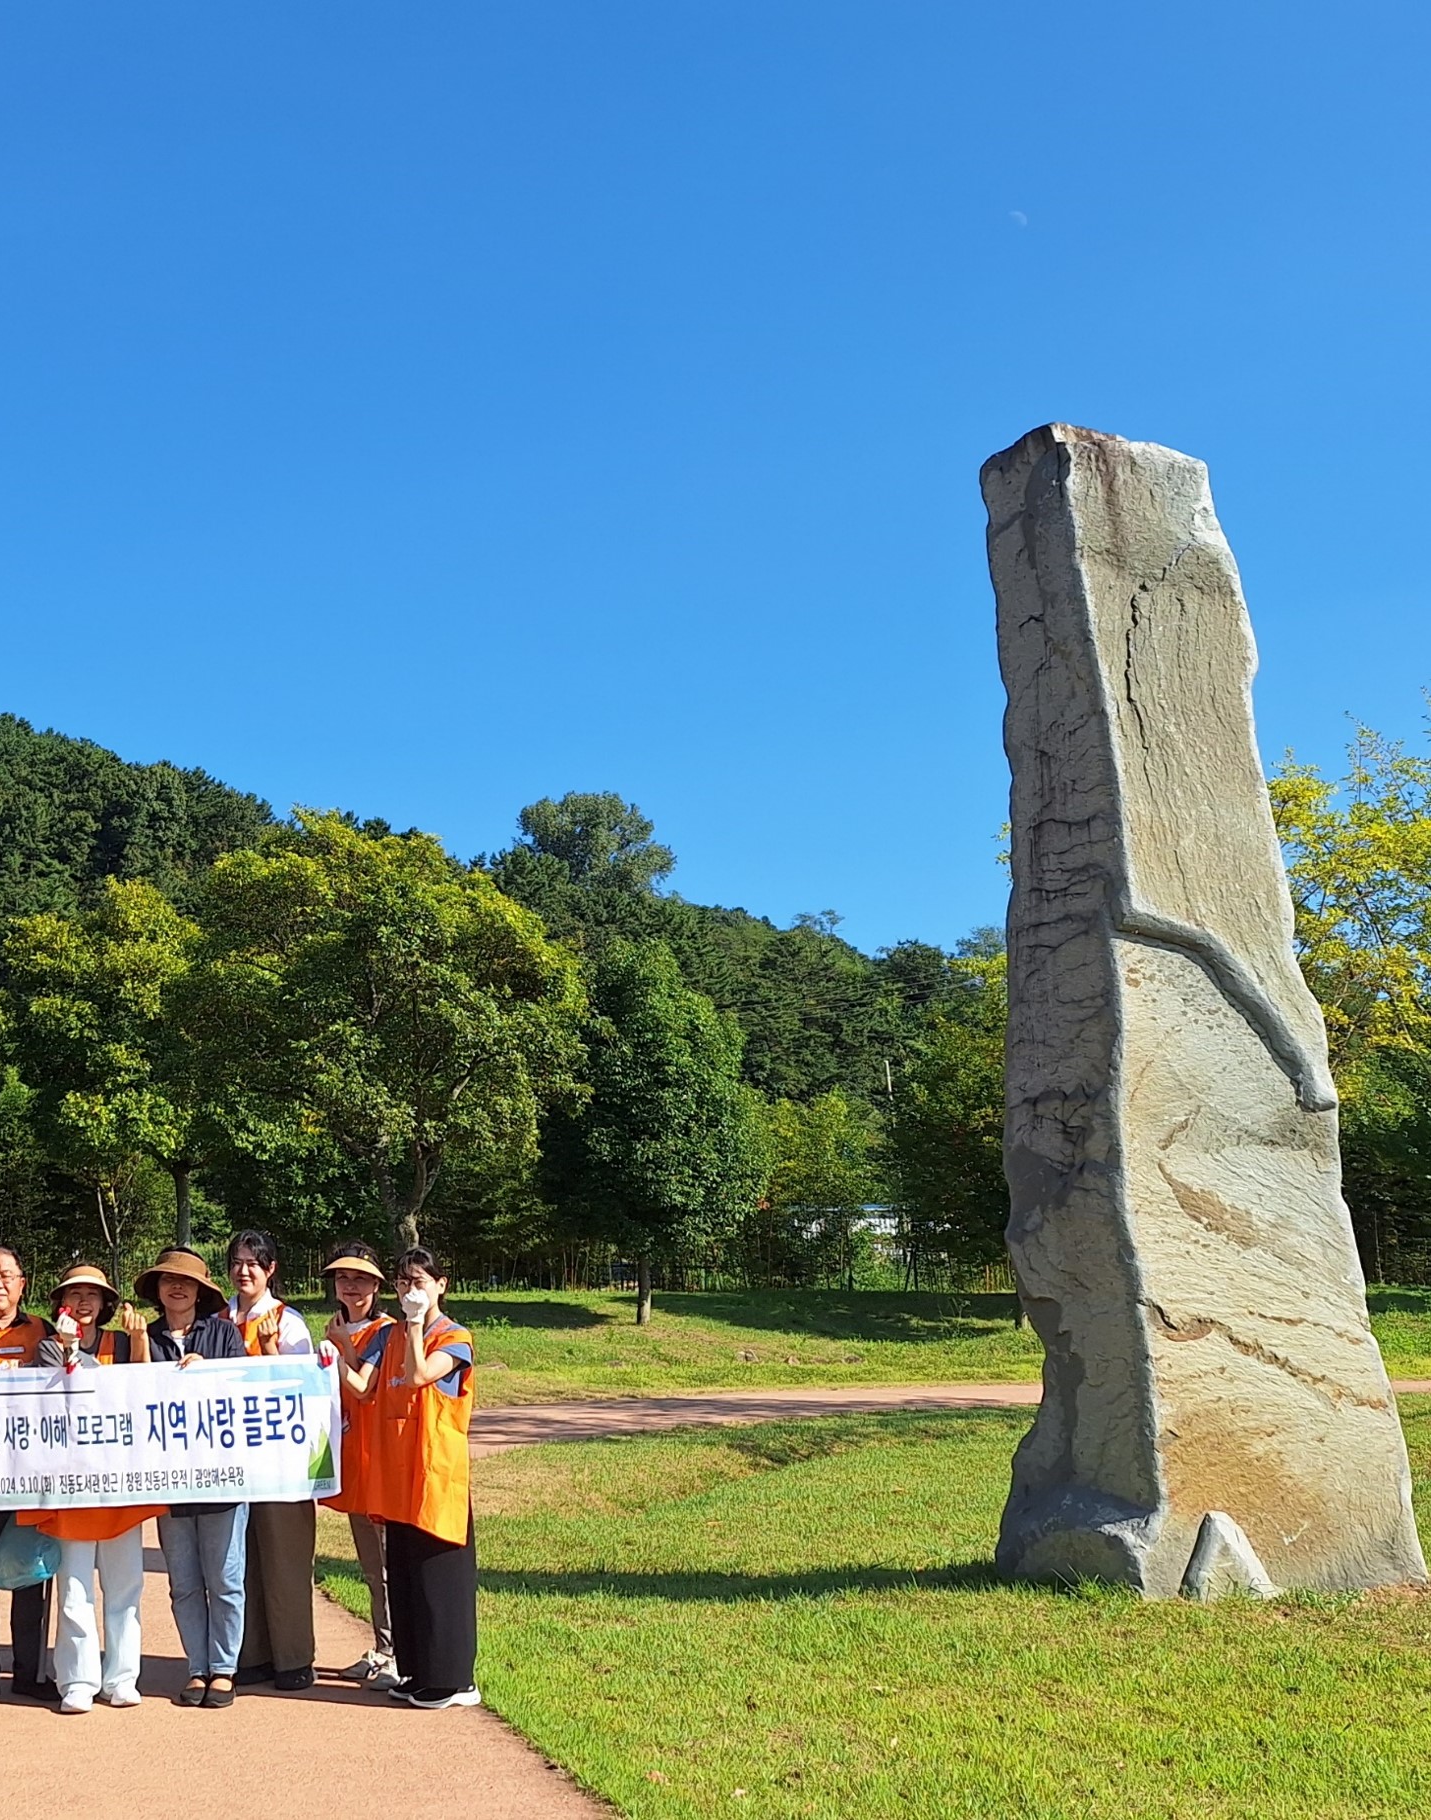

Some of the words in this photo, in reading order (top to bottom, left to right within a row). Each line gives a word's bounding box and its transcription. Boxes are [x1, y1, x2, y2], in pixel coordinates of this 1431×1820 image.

[77, 1412, 133, 1446] 프로그램
[146, 1400, 188, 1451] 지역
[196, 1397, 236, 1449] 사랑
[242, 1393, 306, 1447] 플로깅
[59, 1473, 100, 1495] 진동도서관
[102, 1472, 118, 1493] 인근
[126, 1471, 142, 1492] 창원
[144, 1470, 169, 1491] 진동리
[171, 1469, 188, 1490] 유적
[195, 1466, 244, 1489] 광암해수욕장
